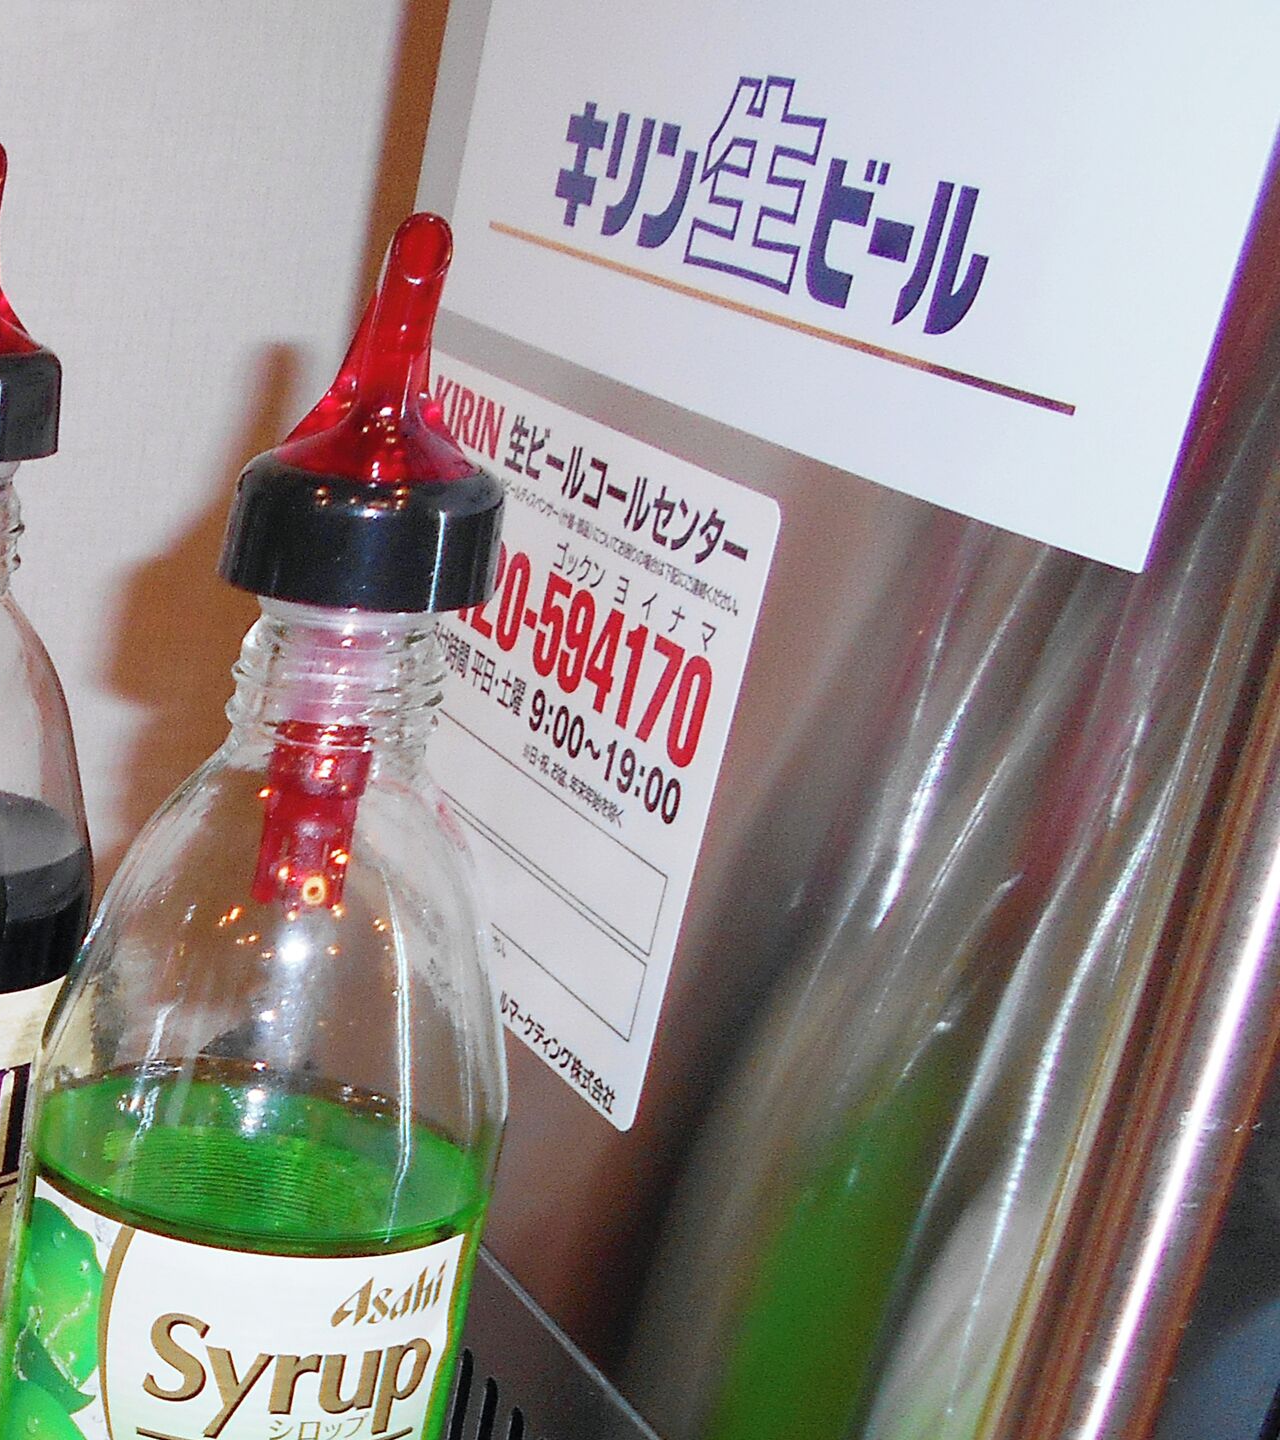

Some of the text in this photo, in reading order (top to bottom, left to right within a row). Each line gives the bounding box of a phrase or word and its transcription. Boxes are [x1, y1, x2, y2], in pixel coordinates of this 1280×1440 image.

[555, 75, 989, 336] キリン生ビール
[435, 375, 505, 460] KIRIN
[505, 415, 749, 564] 生ビールコールセンター
[457, 541, 713, 768] 20-594170
[142, 1312, 432, 1439] Syrup
[331, 1259, 447, 1329] Asahi
